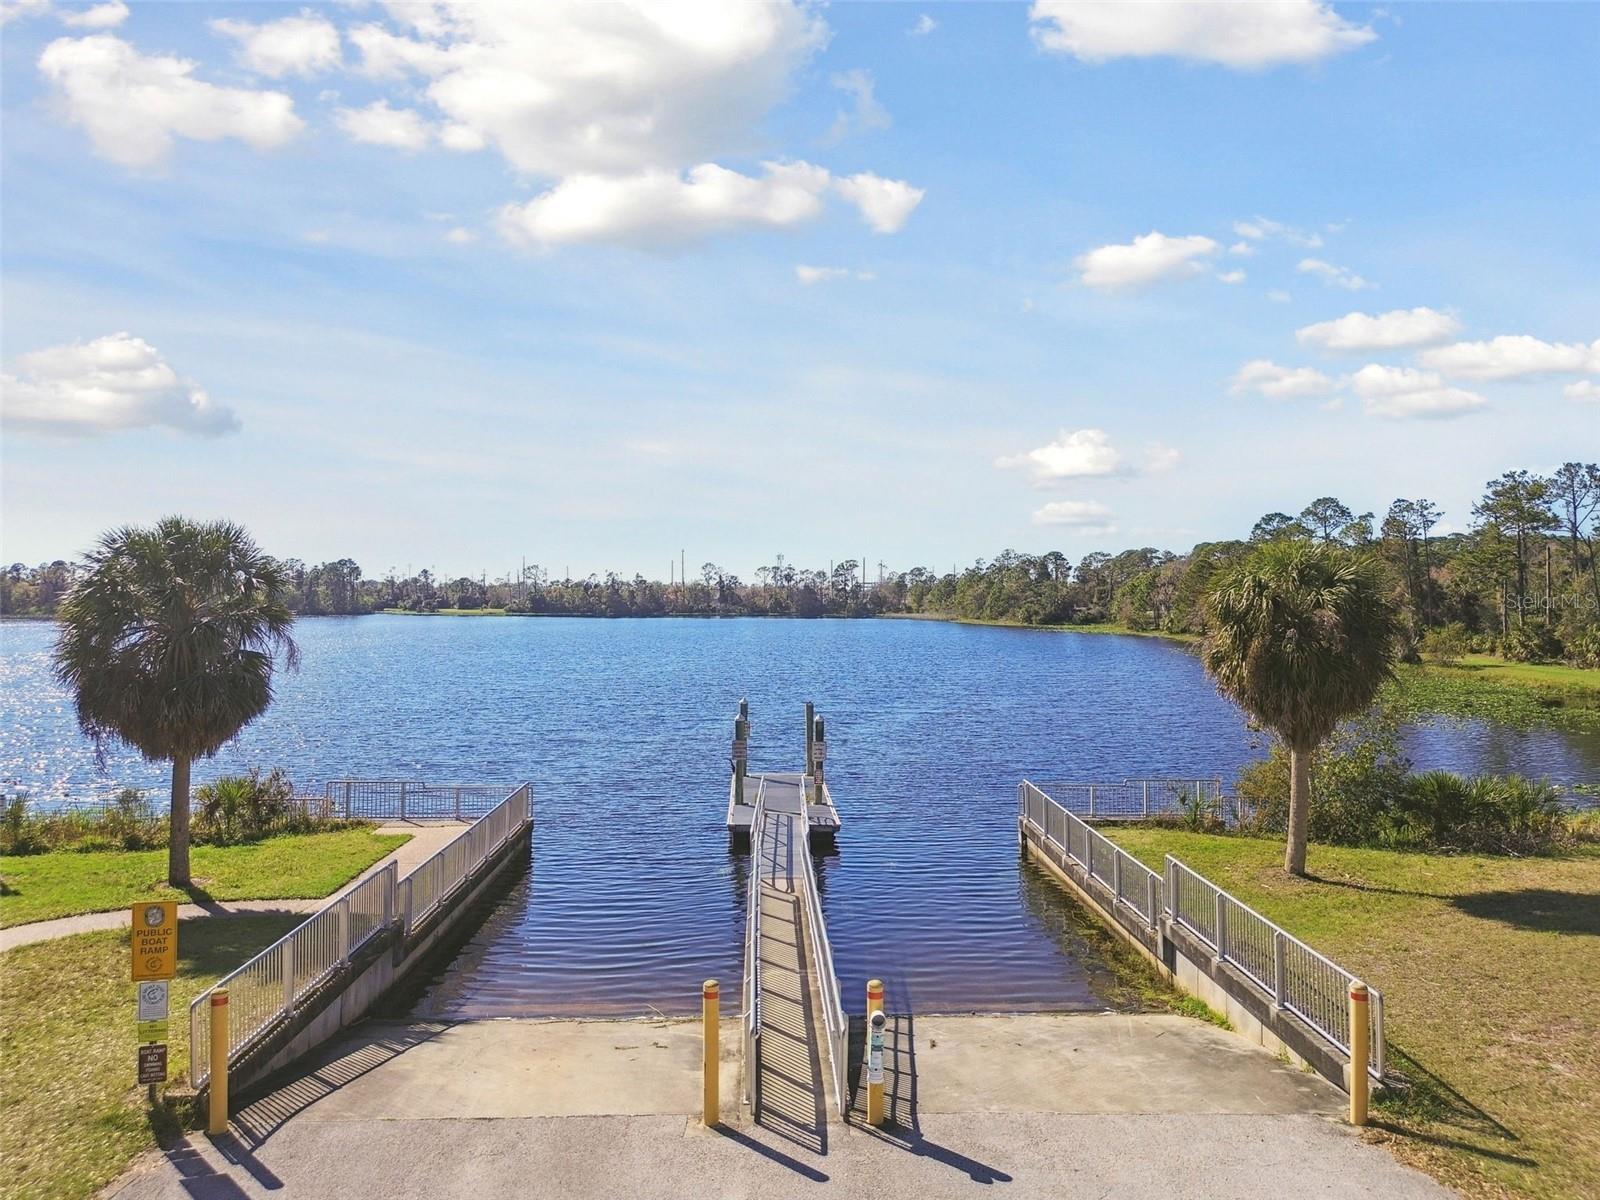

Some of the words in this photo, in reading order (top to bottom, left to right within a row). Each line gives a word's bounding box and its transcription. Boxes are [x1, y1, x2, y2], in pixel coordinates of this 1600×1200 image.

[136, 928, 173, 937] PUBLIC
[141, 937, 168, 946] BOAT
[140, 946, 168, 955] RAMP
[148, 1054, 158, 1062] NO
